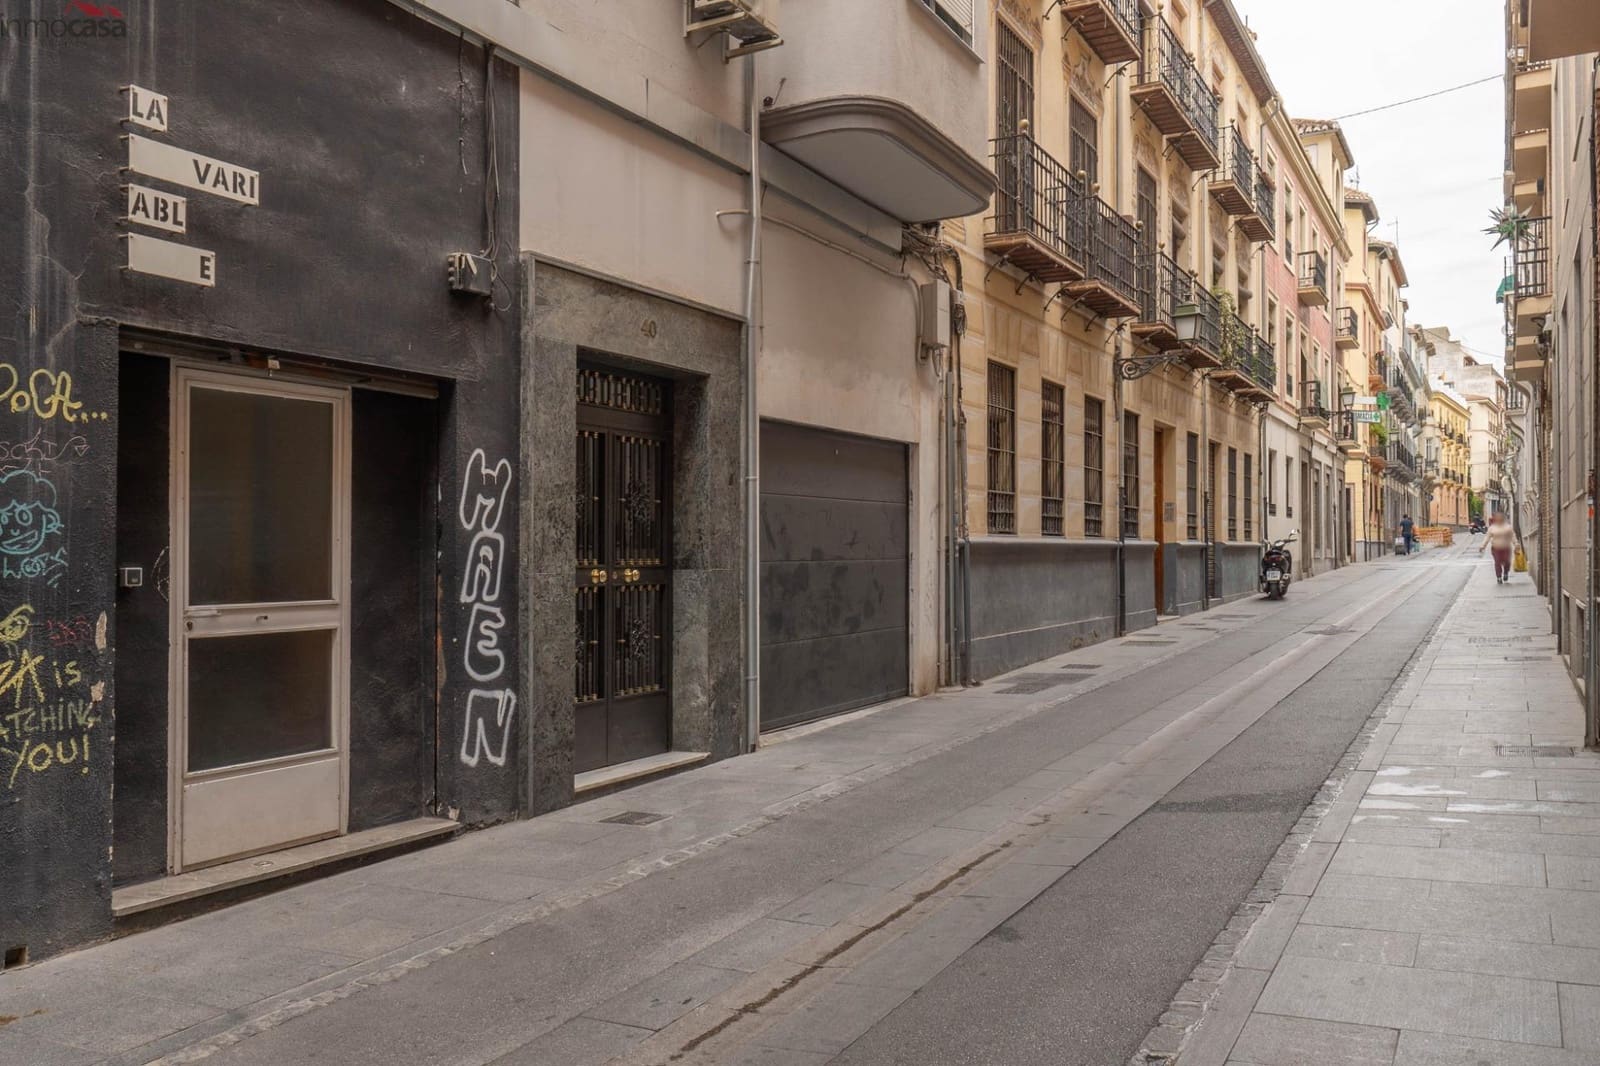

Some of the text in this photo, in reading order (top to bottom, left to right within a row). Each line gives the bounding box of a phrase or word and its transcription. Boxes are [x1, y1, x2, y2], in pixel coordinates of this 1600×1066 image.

[131, 91, 165, 126] LA
[192, 158, 255, 199] VARI
[131, 191, 184, 227] ABL
[199, 255, 211, 281] E
